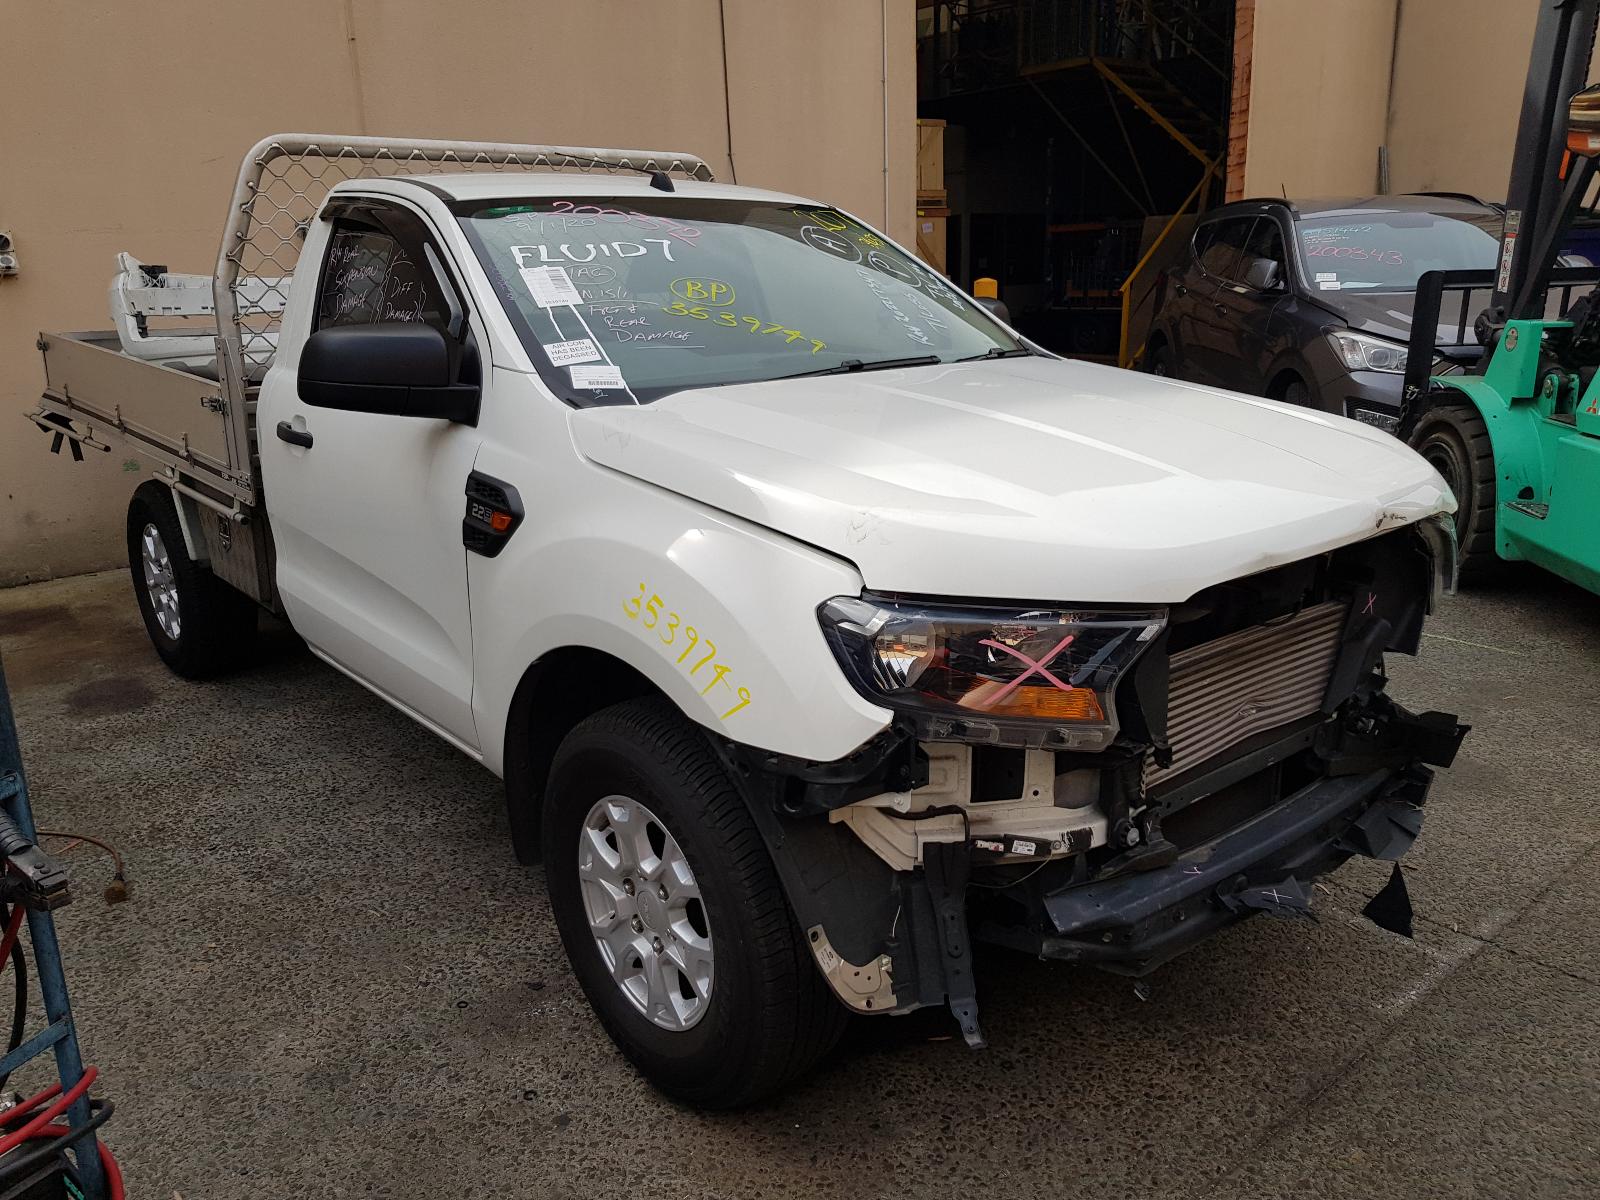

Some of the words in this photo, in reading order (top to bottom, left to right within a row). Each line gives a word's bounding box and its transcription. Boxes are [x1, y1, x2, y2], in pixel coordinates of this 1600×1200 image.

[686, 280, 727, 301] BP
[551, 348, 568, 356] HAS
[569, 345, 592, 353] BEEN
[622, 582, 751, 721] 3539749
